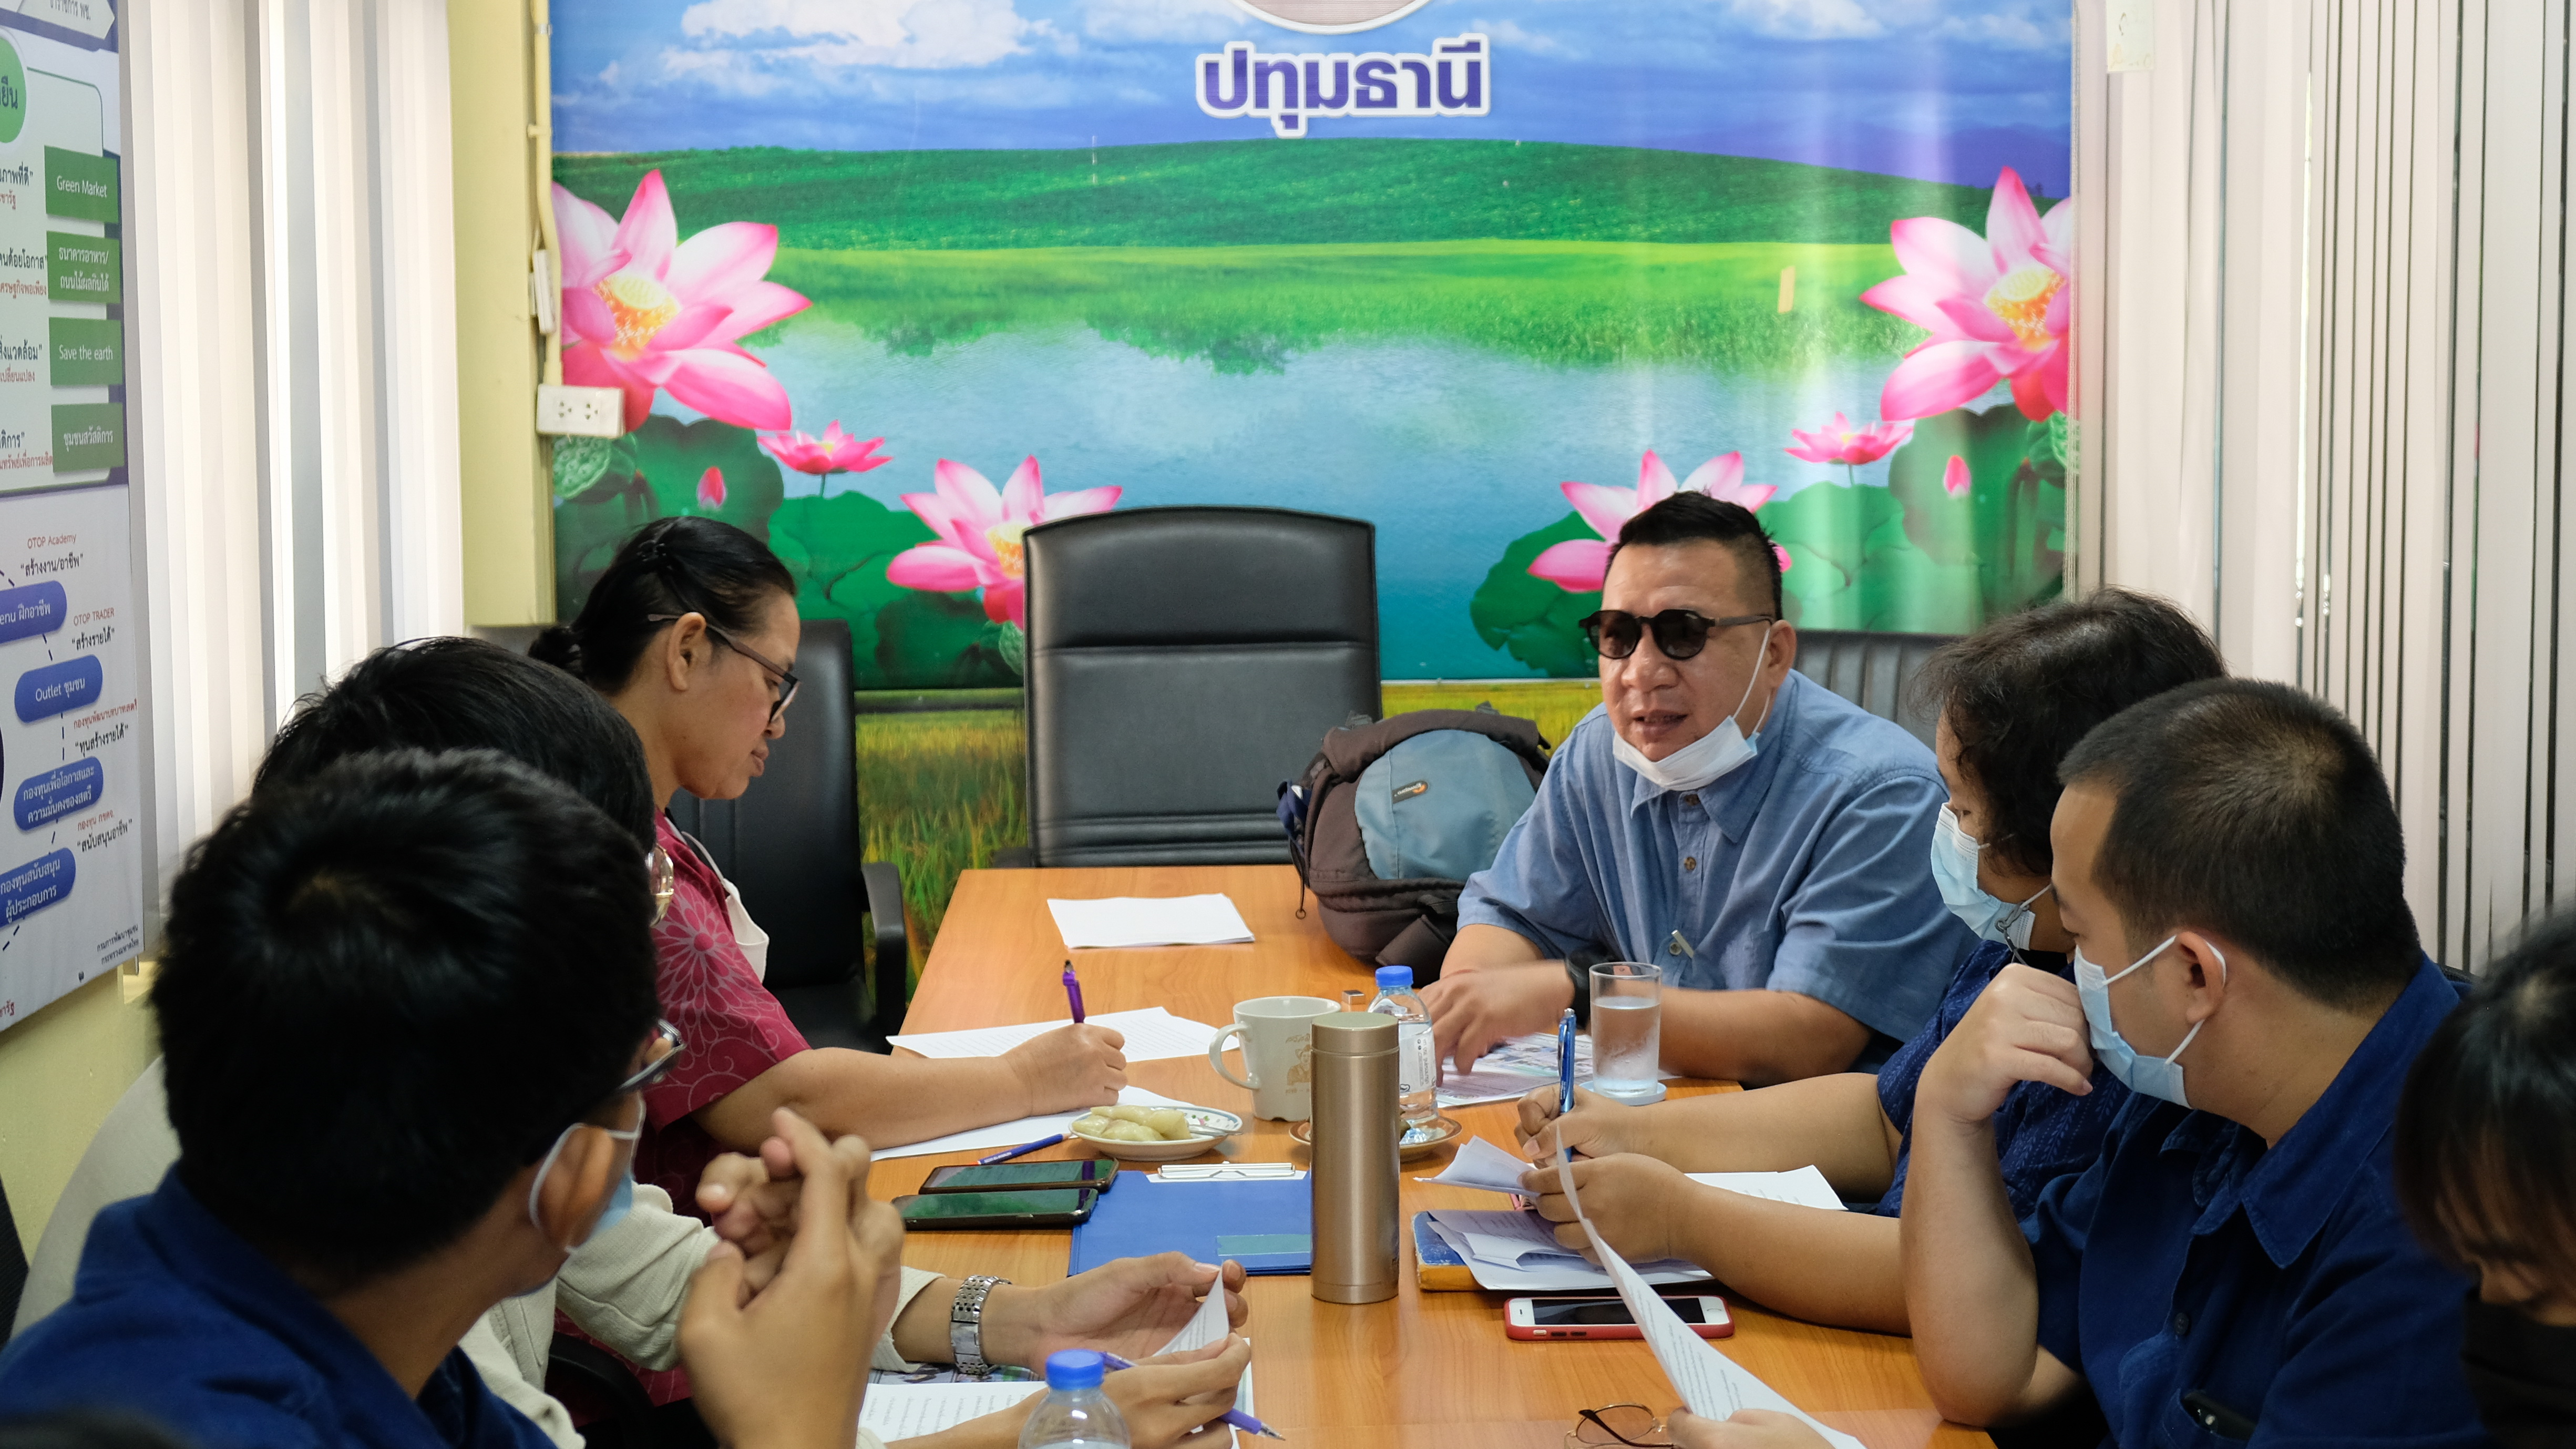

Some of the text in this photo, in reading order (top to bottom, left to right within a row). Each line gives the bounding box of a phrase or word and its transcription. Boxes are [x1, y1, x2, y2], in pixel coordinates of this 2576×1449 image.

[0, 76, 18, 110] ยืน
[1204, 41, 1482, 130] ปทุมธานี
[57, 175, 107, 198] Green Market
[59, 247, 109, 264] ธนาคารอาหาร/
[59, 344, 113, 361] Save the earth
[0, 429, 25, 449] ดิการ"
[64, 425, 113, 452] ชุมชนสวัสดิการ
[27, 534, 76, 549] OTOP Academy
[18, 599, 50, 621] ฝึกอาชีพ
[74, 607, 115, 627] OTOP TRADER
[35, 677, 85, 702] Outlet ชุมชน
[1, 859, 60, 894] กองทุนสนับสนุน
[6, 885, 57, 924] ผู้ประกอบการ
